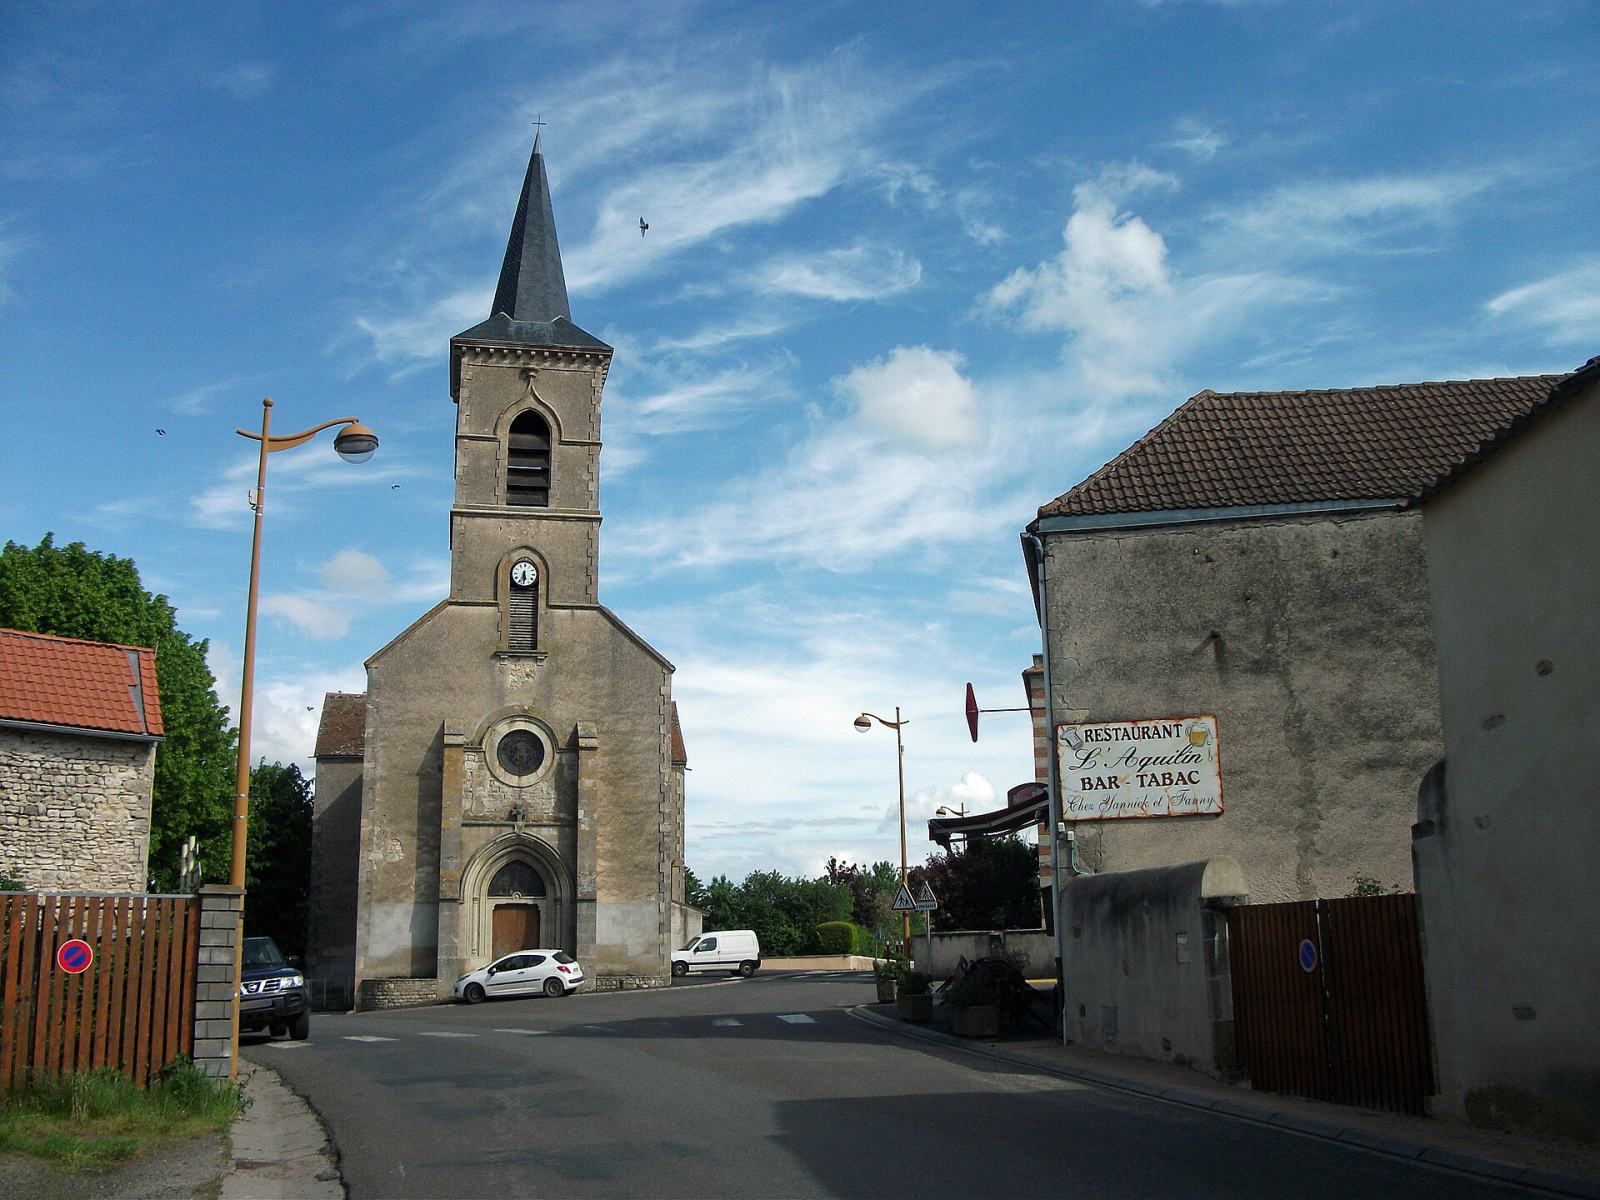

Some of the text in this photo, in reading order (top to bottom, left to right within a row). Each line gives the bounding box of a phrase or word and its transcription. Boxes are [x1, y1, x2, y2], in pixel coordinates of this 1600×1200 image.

[1084, 724, 1182, 743] RESTAURANT
[1069, 744, 1203, 773] L'Aquilin
[1081, 776, 1120, 791] BAR
[1136, 770, 1201, 788] TABAC
[1066, 789, 1217, 812] Chez Yannick et Fanny
